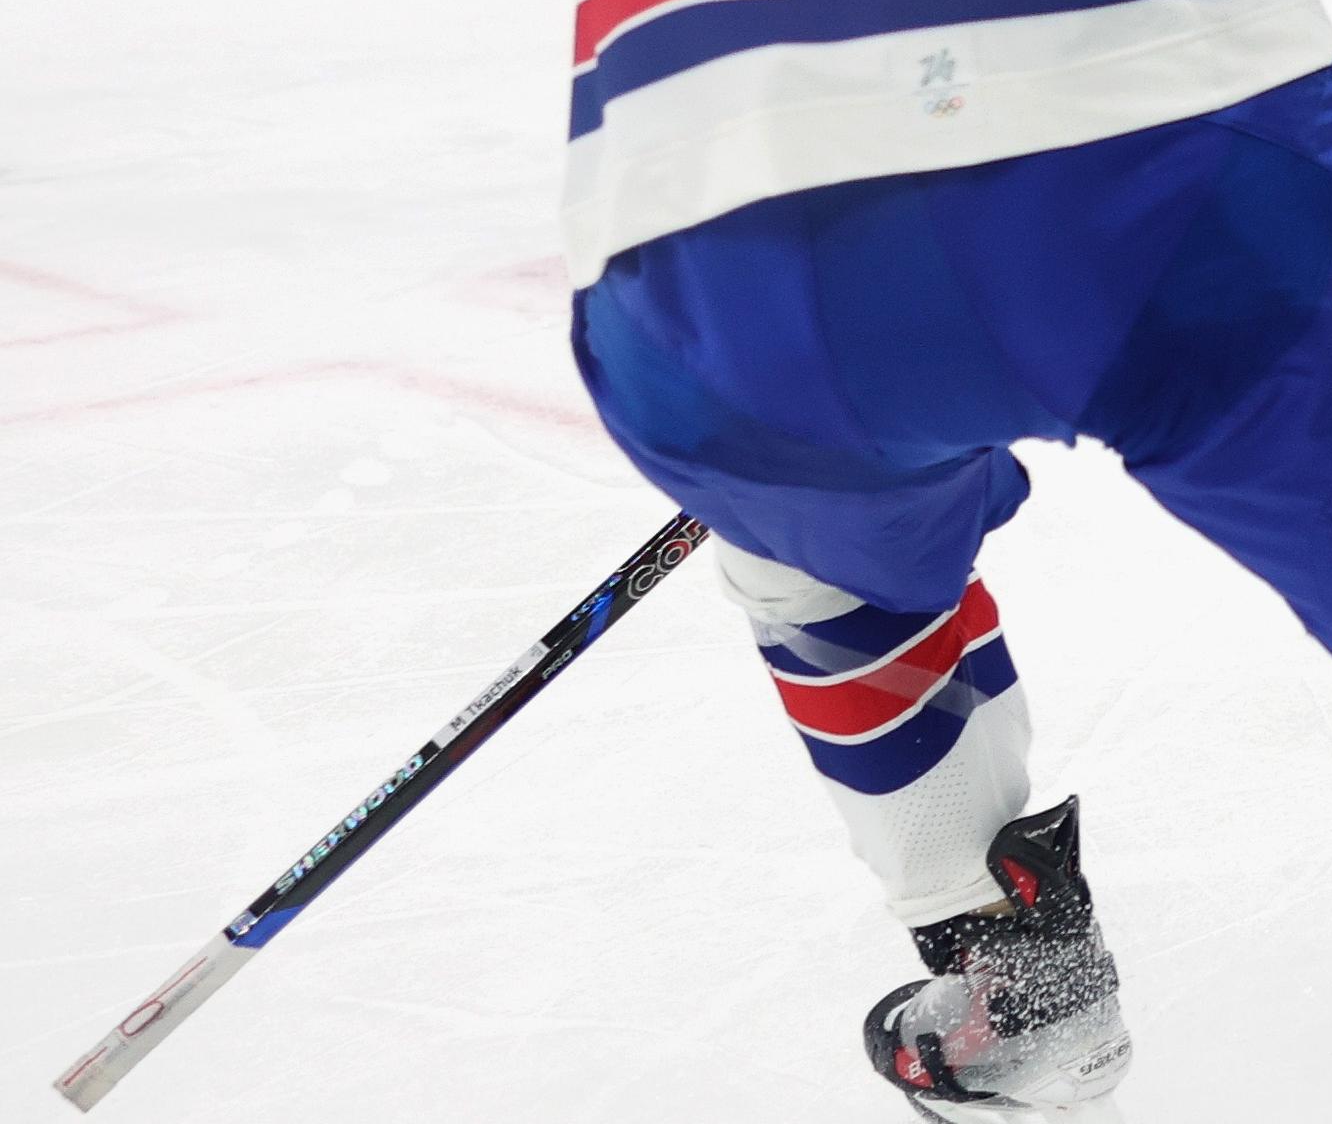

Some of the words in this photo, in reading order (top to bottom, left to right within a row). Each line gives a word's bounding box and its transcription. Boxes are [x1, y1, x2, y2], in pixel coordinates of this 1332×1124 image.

[541, 648, 573, 680] PRO
[449, 714, 468, 732] M
[463, 664, 525, 719] Tkachuk
